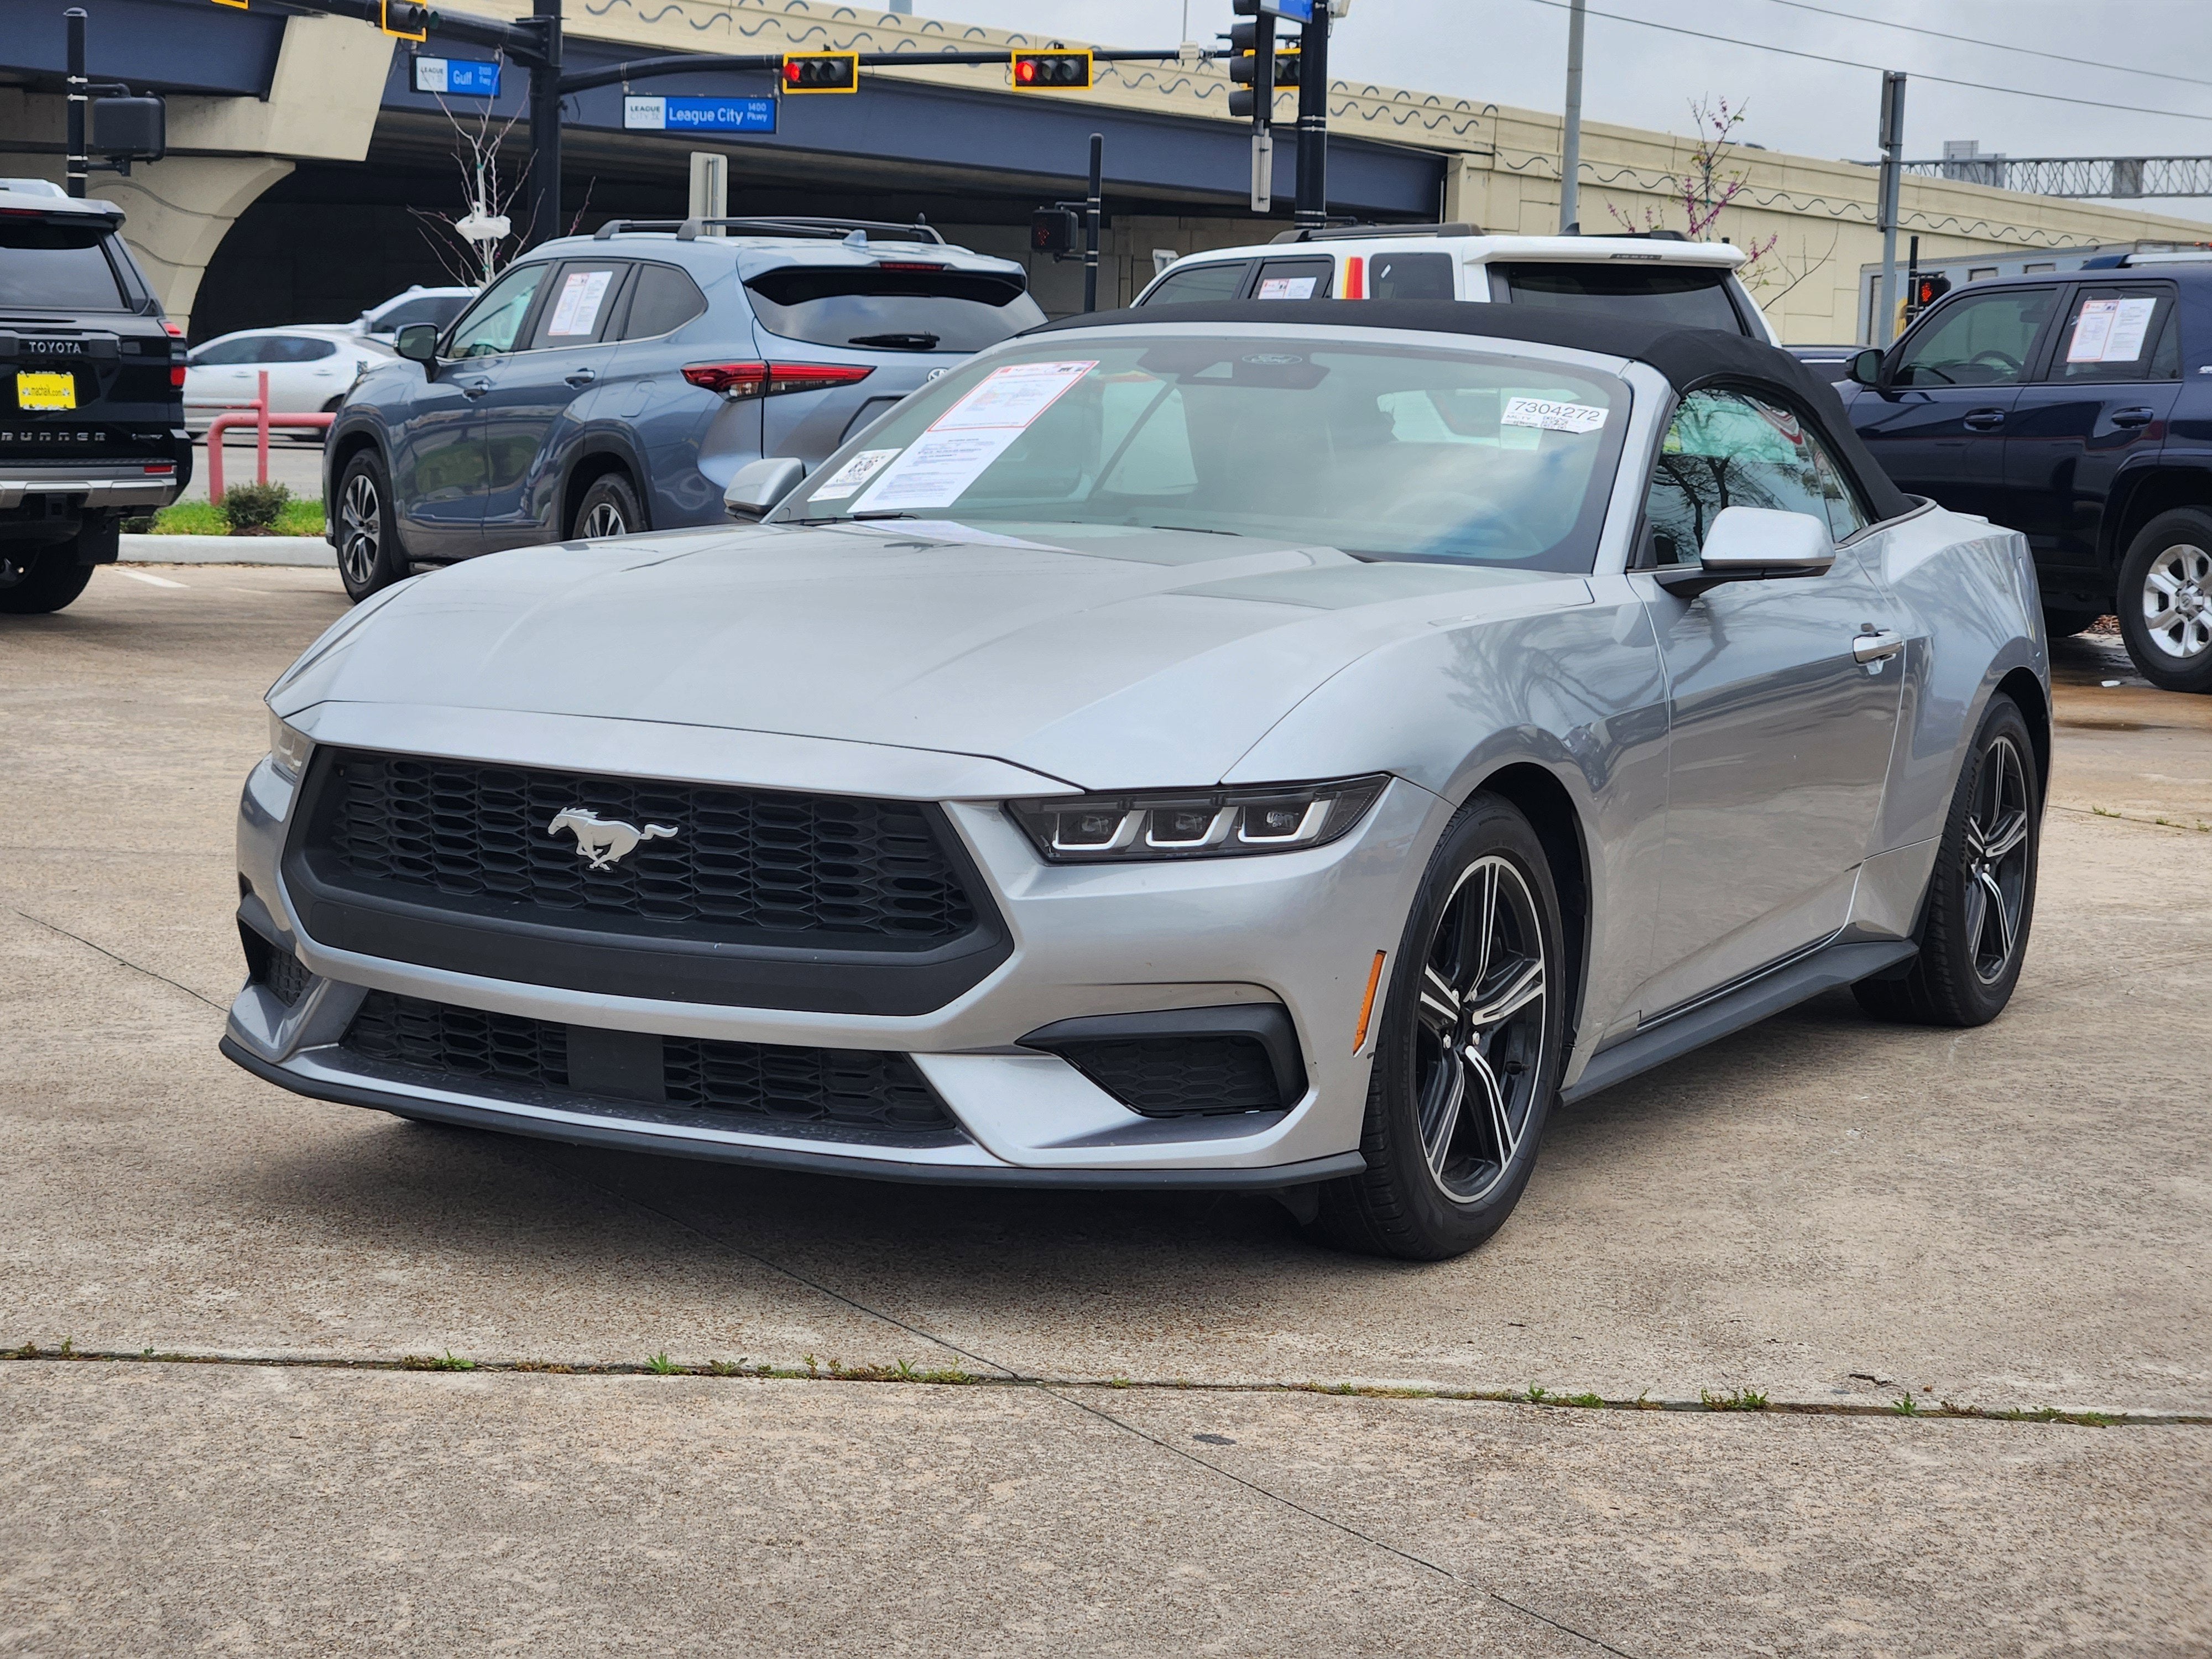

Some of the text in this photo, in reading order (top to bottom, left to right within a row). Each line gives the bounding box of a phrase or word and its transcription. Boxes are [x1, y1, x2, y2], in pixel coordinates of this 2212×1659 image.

[453, 70, 472, 85] Gulf
[748, 102, 767, 112] 1400
[669, 107, 744, 126] League City
[747, 112, 768, 123] Pkwy
[29, 341, 82, 353] TOYOTA
[1514, 401, 1600, 422] 7304272
